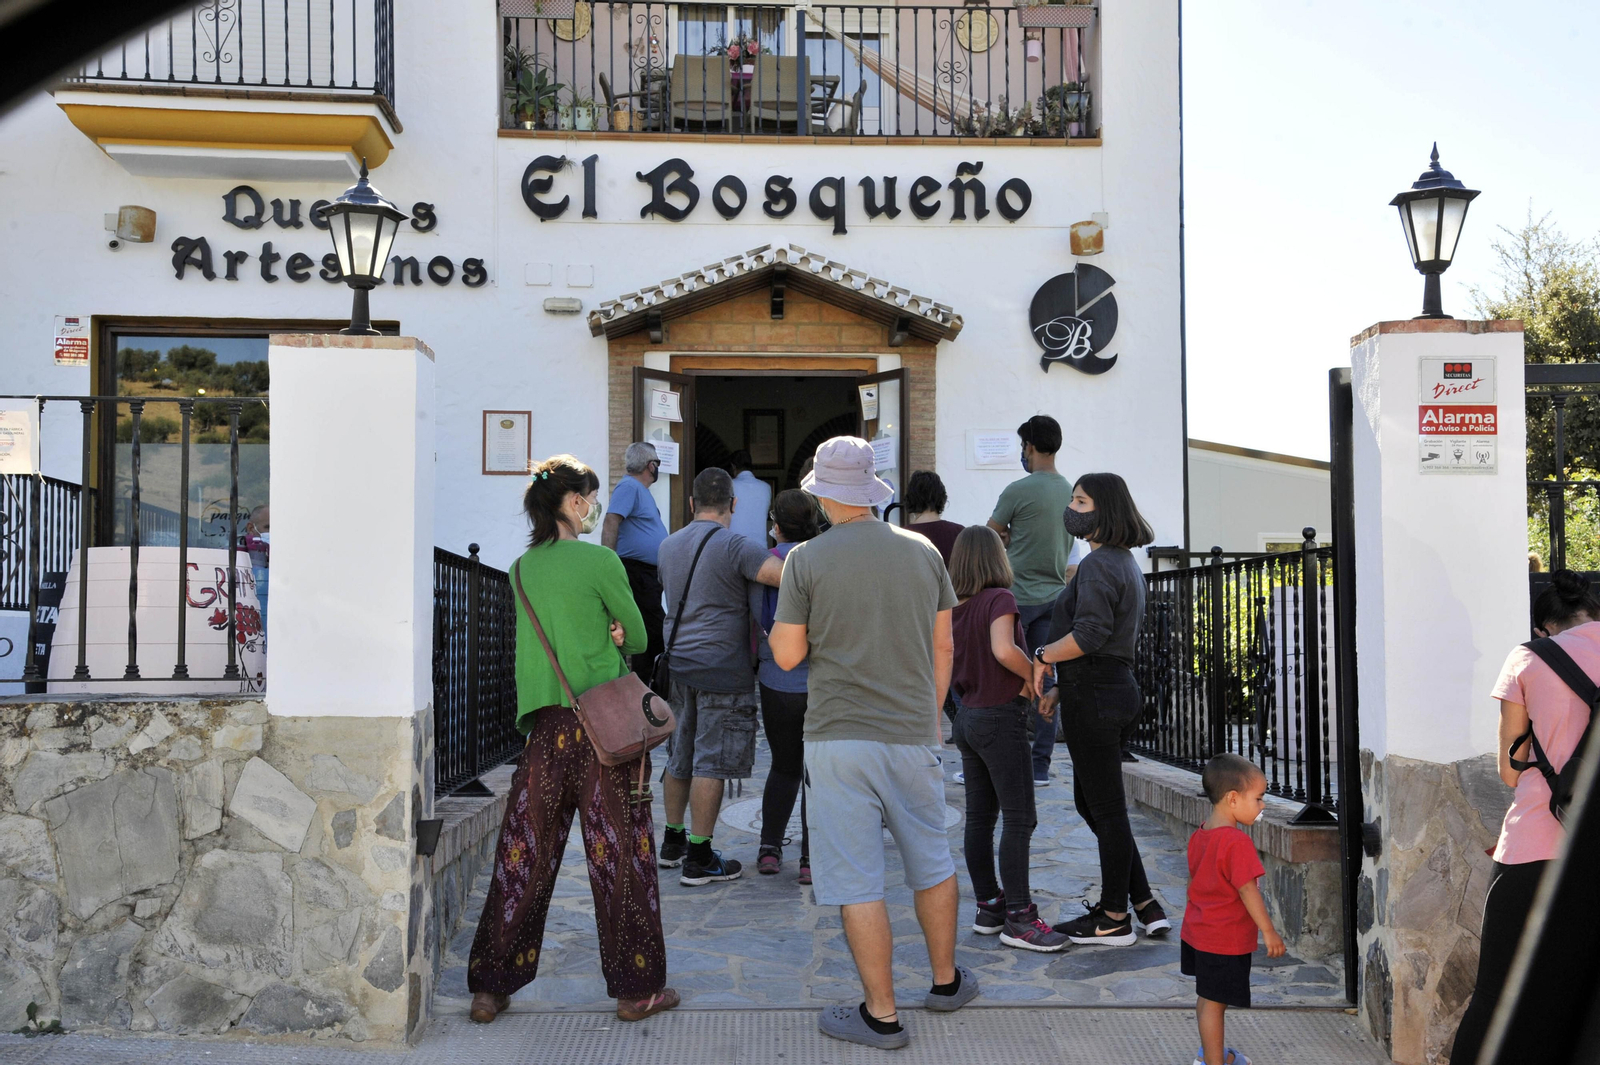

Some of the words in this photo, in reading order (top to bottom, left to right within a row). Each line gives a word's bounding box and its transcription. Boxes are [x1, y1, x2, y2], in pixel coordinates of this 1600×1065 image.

[521, 154, 599, 222] El
[636, 161, 1032, 235] Bosqueño
[222, 185, 438, 232] Ques
[171, 236, 488, 288] Artesnos
[56, 338, 87, 346] Alarma
[1432, 378, 1486, 399] Direct
[1421, 408, 1495, 424] Alarma
[1438, 424, 1460, 432] Aviso
[1469, 424, 1495, 432] Policía
